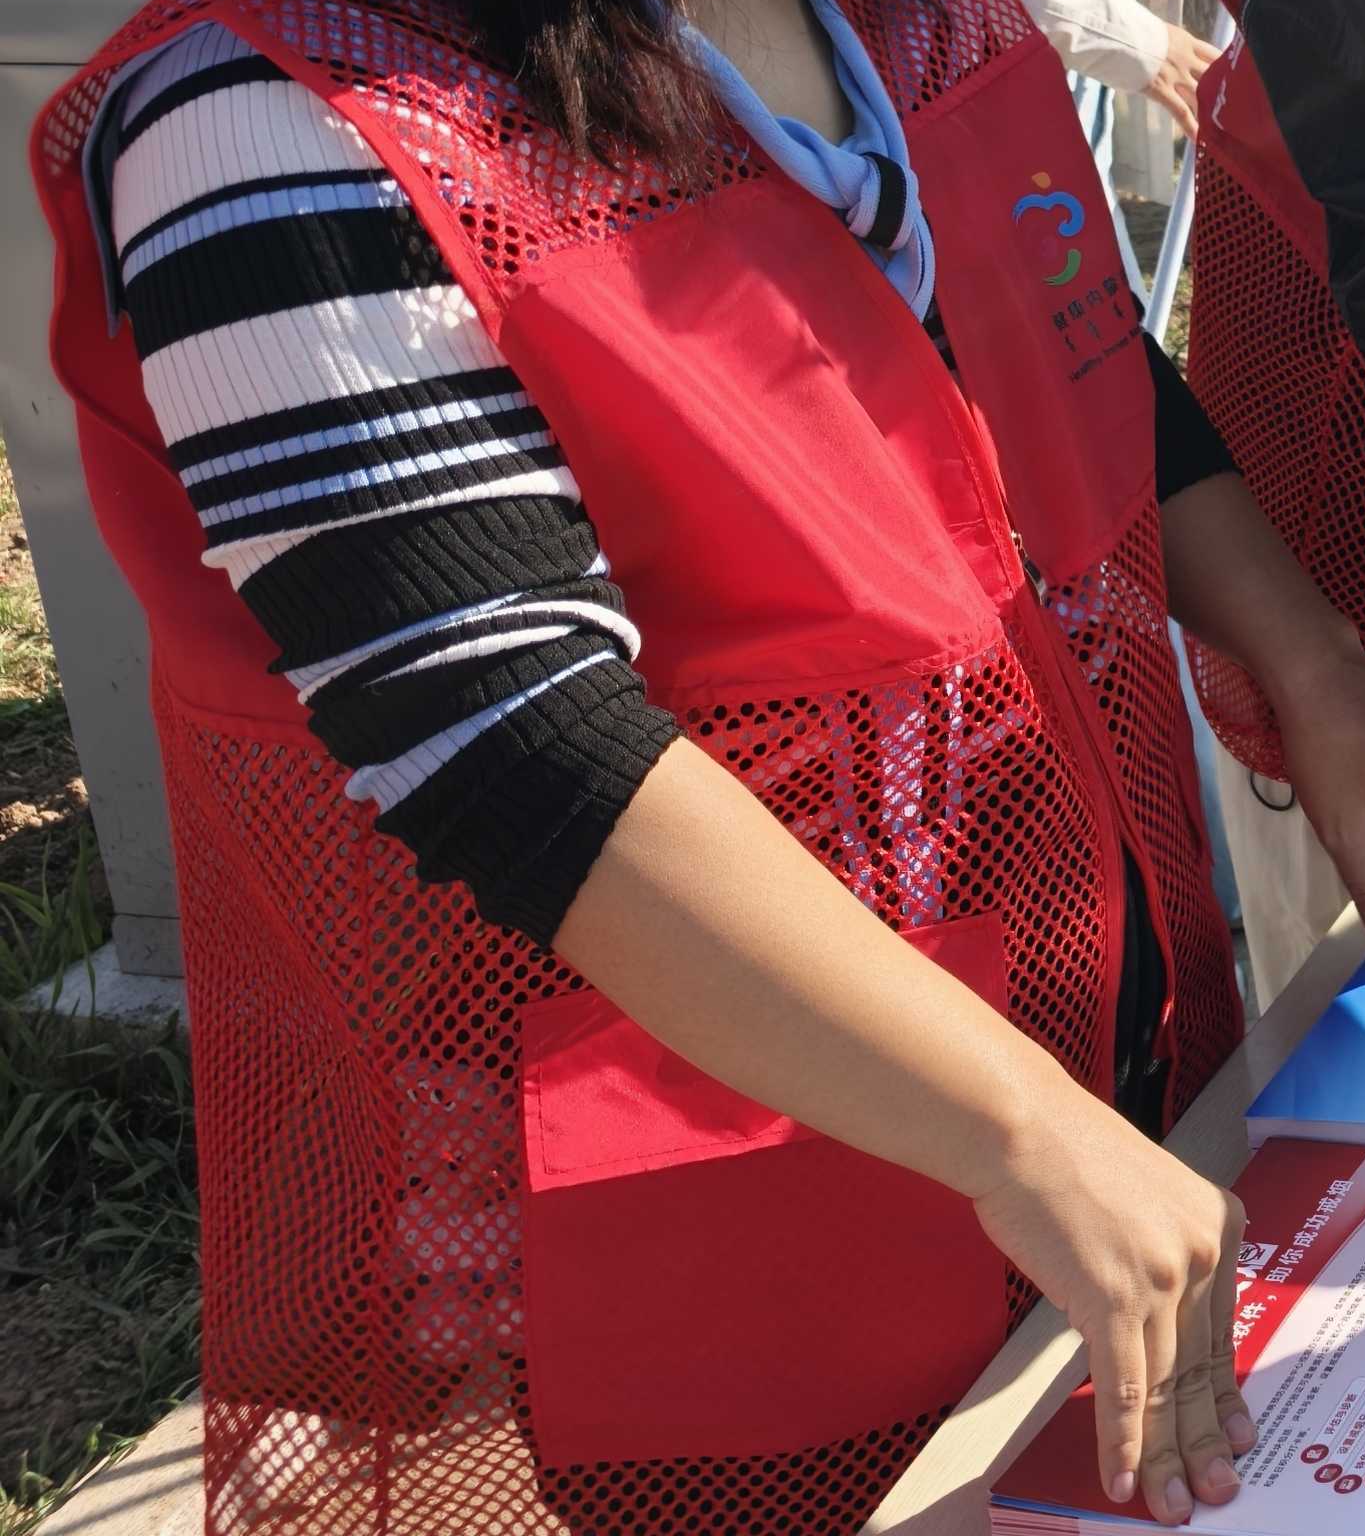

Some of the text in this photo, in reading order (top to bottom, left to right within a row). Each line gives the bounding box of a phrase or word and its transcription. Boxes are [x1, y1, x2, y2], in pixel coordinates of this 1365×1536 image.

[1233, 1178, 1354, 1352] 软件，助你成功戒烟
[1322, 1393, 1358, 1434] 评估与诊断
